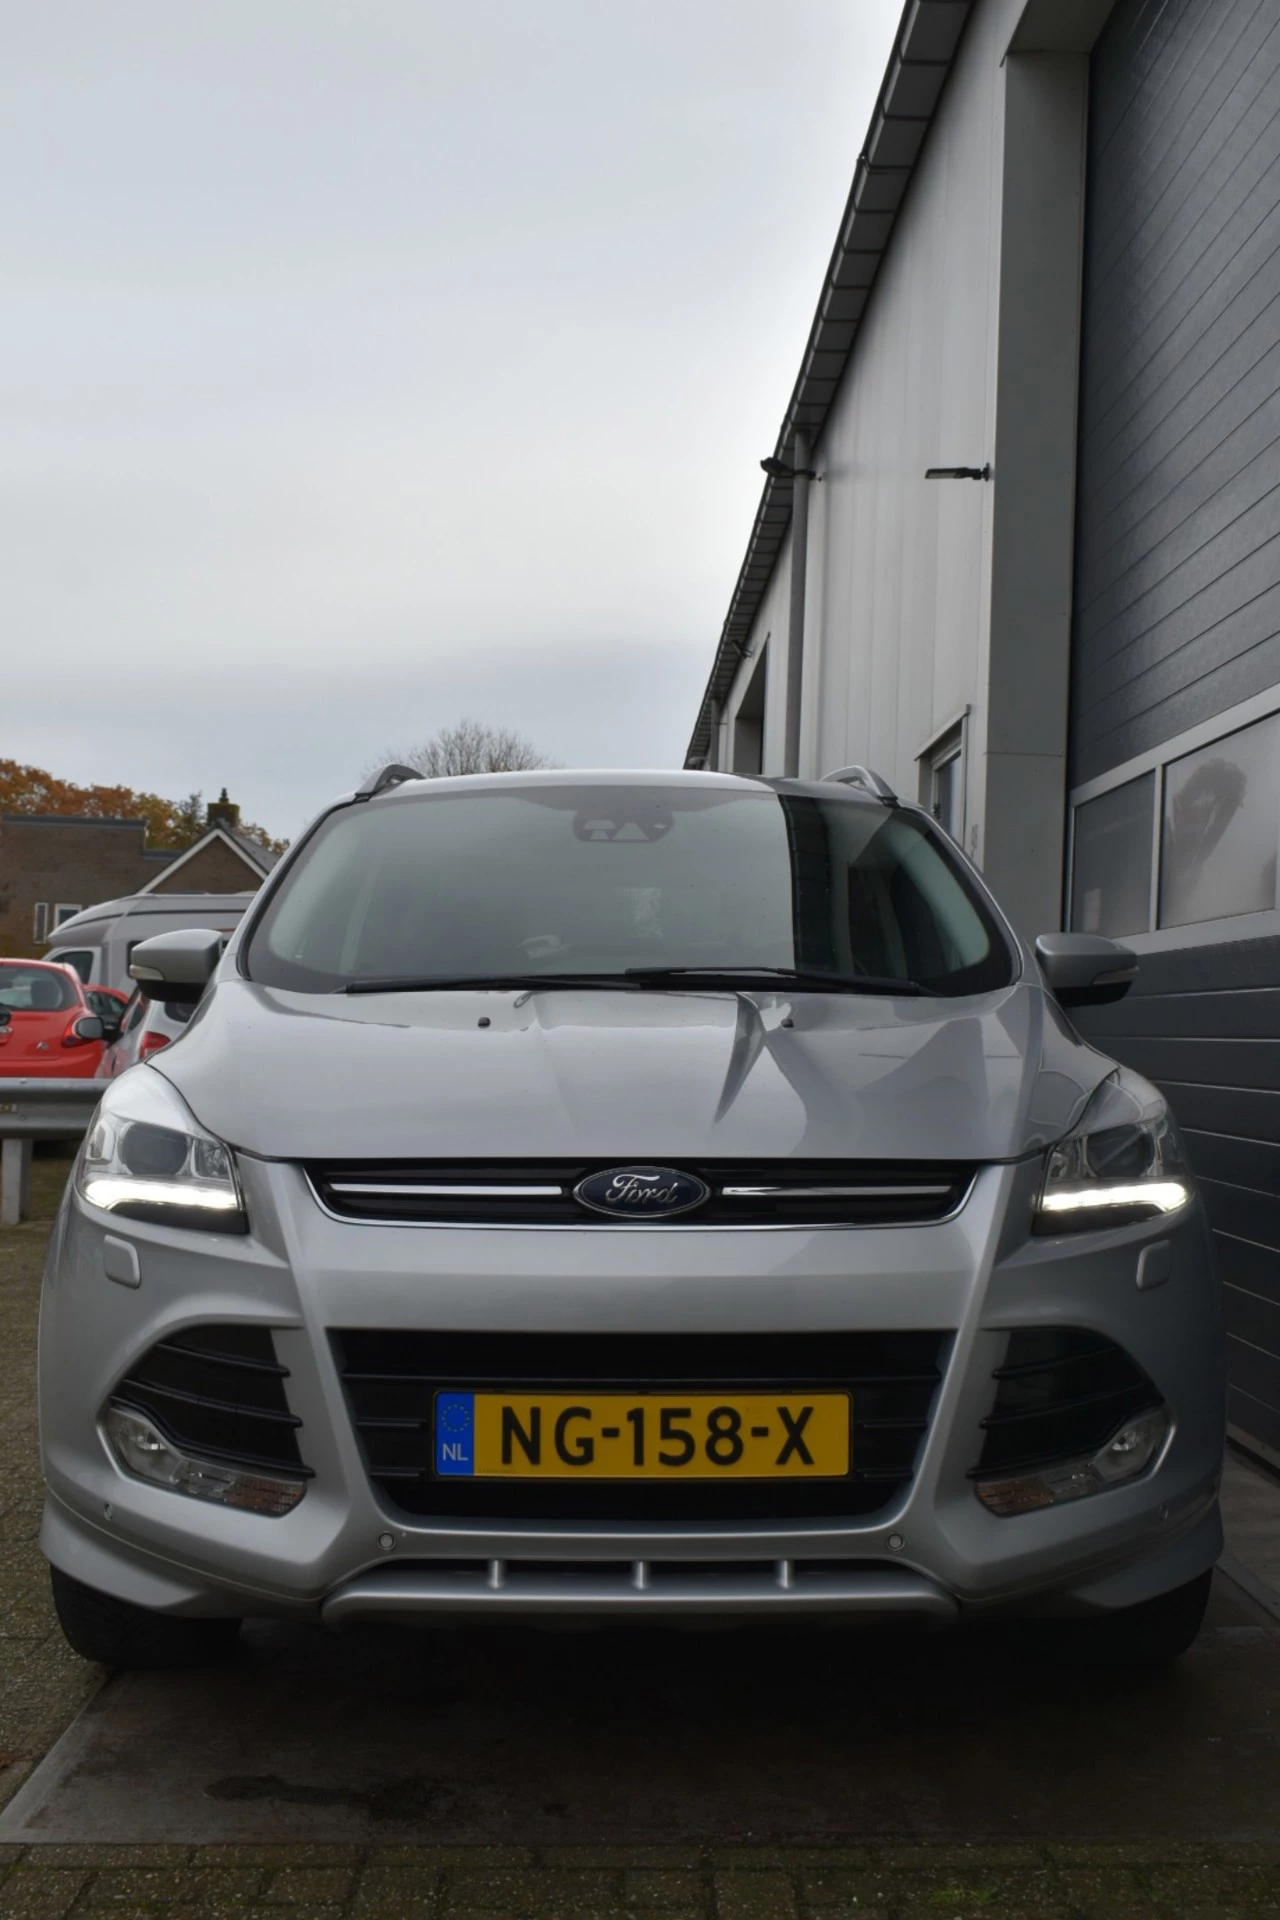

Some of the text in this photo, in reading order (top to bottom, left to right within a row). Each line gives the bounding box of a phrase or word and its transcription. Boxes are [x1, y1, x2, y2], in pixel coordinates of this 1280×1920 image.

[605, 1173, 679, 1204] Ford
[442, 1443, 469, 1461] NL
[501, 1406, 815, 1467] NG-158-X
